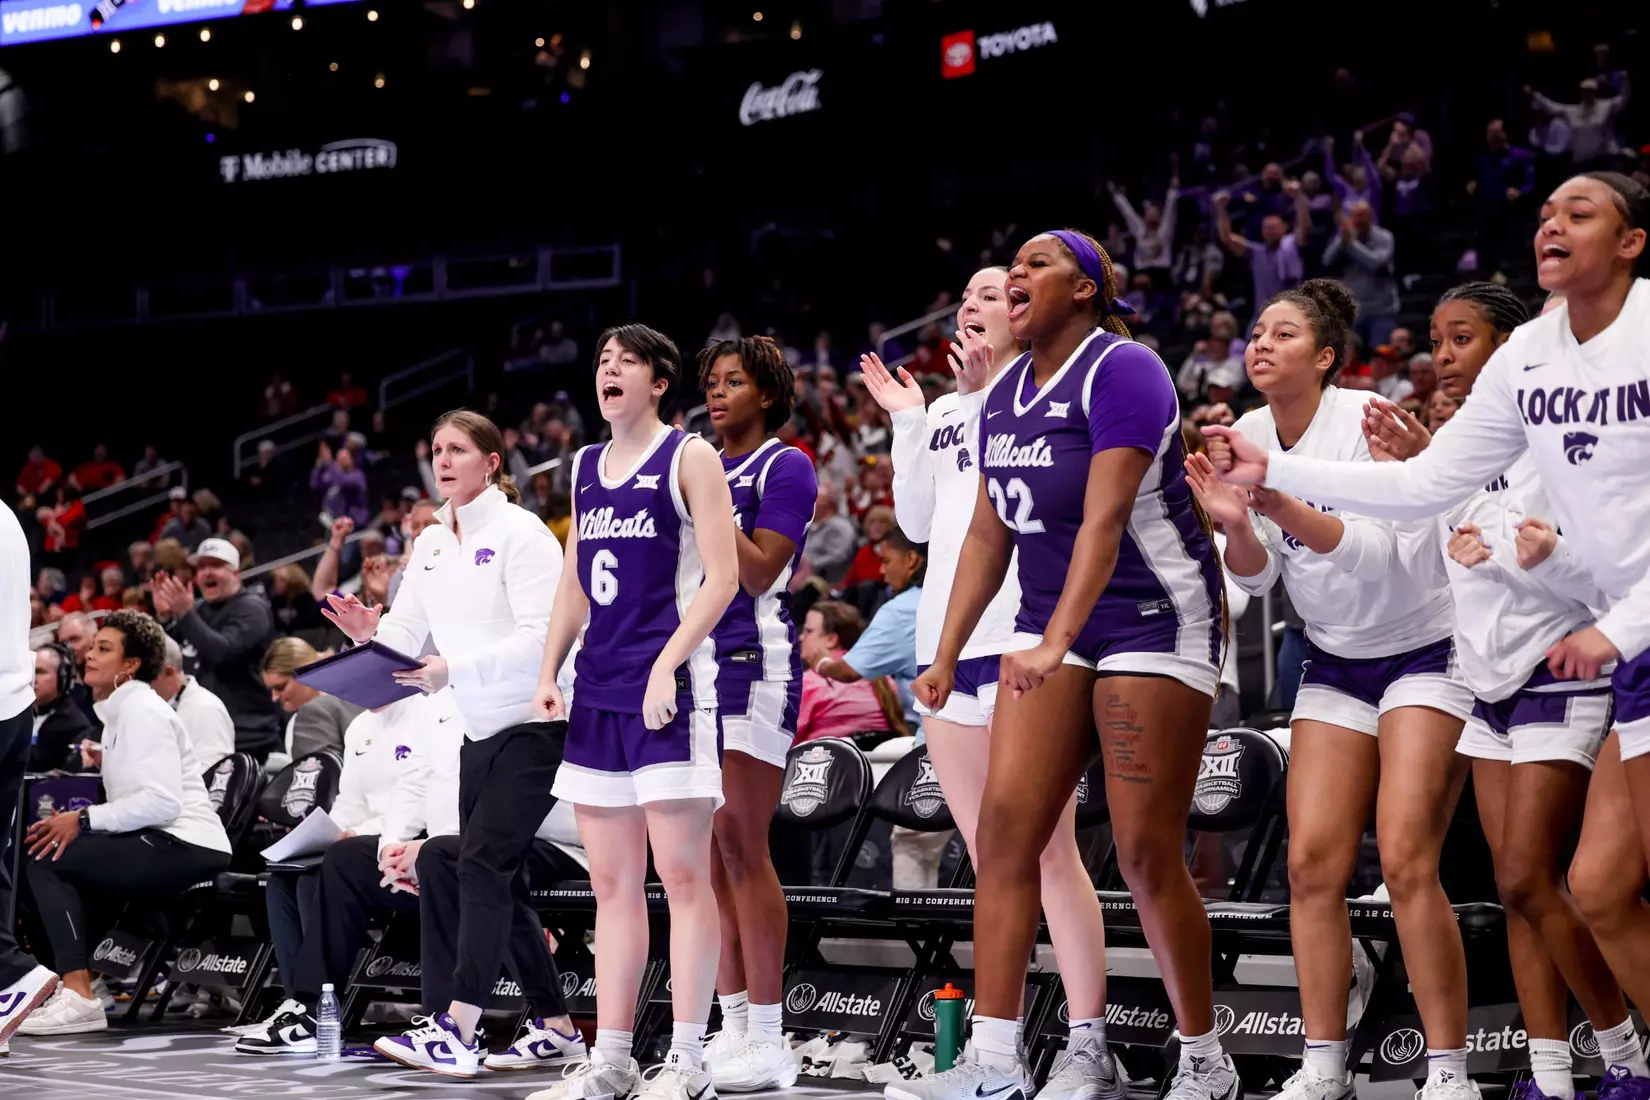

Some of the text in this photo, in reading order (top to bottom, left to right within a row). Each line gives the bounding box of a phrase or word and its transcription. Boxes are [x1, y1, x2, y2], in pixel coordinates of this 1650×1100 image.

[3, 3, 82, 35] venmo
[977, 21, 1058, 59] TOYOTA
[315, 146, 388, 173] CENTER
[987, 477, 1047, 535] 22
[578, 506, 658, 542] Wildcats
[591, 549, 618, 606] 6
[793, 761, 831, 786] XII
[1198, 752, 1241, 780] XII
[1195, 785, 1239, 796] OURNAMENT
[1198, 780, 1238, 790] ASKETBALL
[785, 895, 838, 903] CONFERENCE
[895, 896, 975, 906] BIG 12 CONFERENC
[1100, 902, 1137, 910] ERENCE
[1349, 909, 1361, 917] IG
[106, 945, 137, 966] Allstate
[196, 953, 247, 974] Allstate
[812, 991, 881, 1017] Allstate
[1466, 1025, 1527, 1053] state
